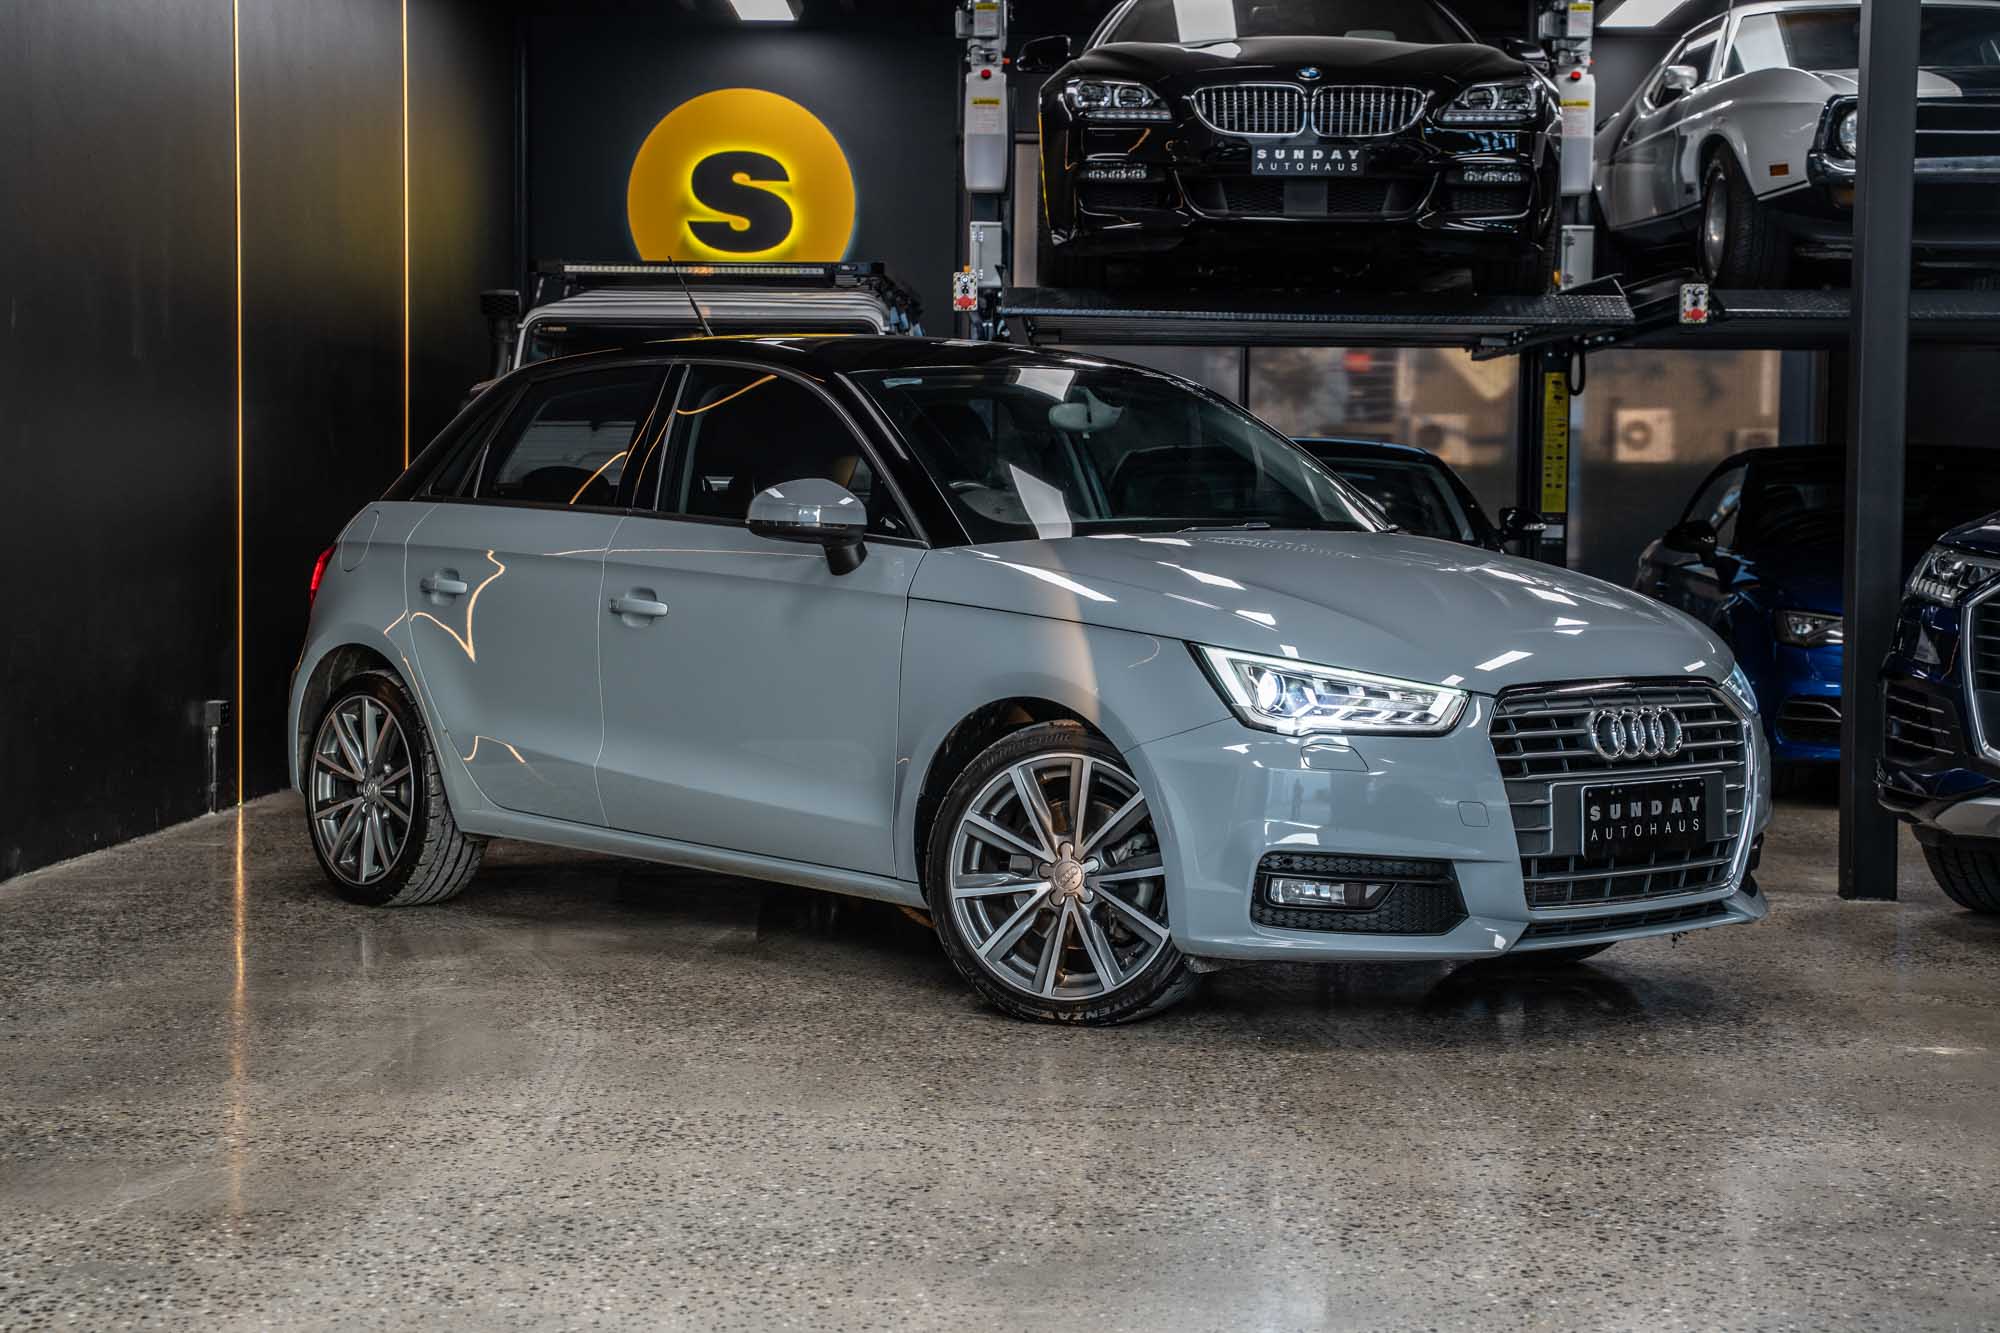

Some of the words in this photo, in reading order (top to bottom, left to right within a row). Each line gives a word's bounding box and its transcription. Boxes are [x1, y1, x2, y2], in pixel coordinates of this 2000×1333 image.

[1256, 149, 1359, 160] SUNDAY
[1256, 162, 1358, 172] AUTOHAUS
[688, 151, 793, 254] S
[1590, 796, 1700, 821] SUNDAY
[1591, 818, 1700, 841] AUTOHAUS
